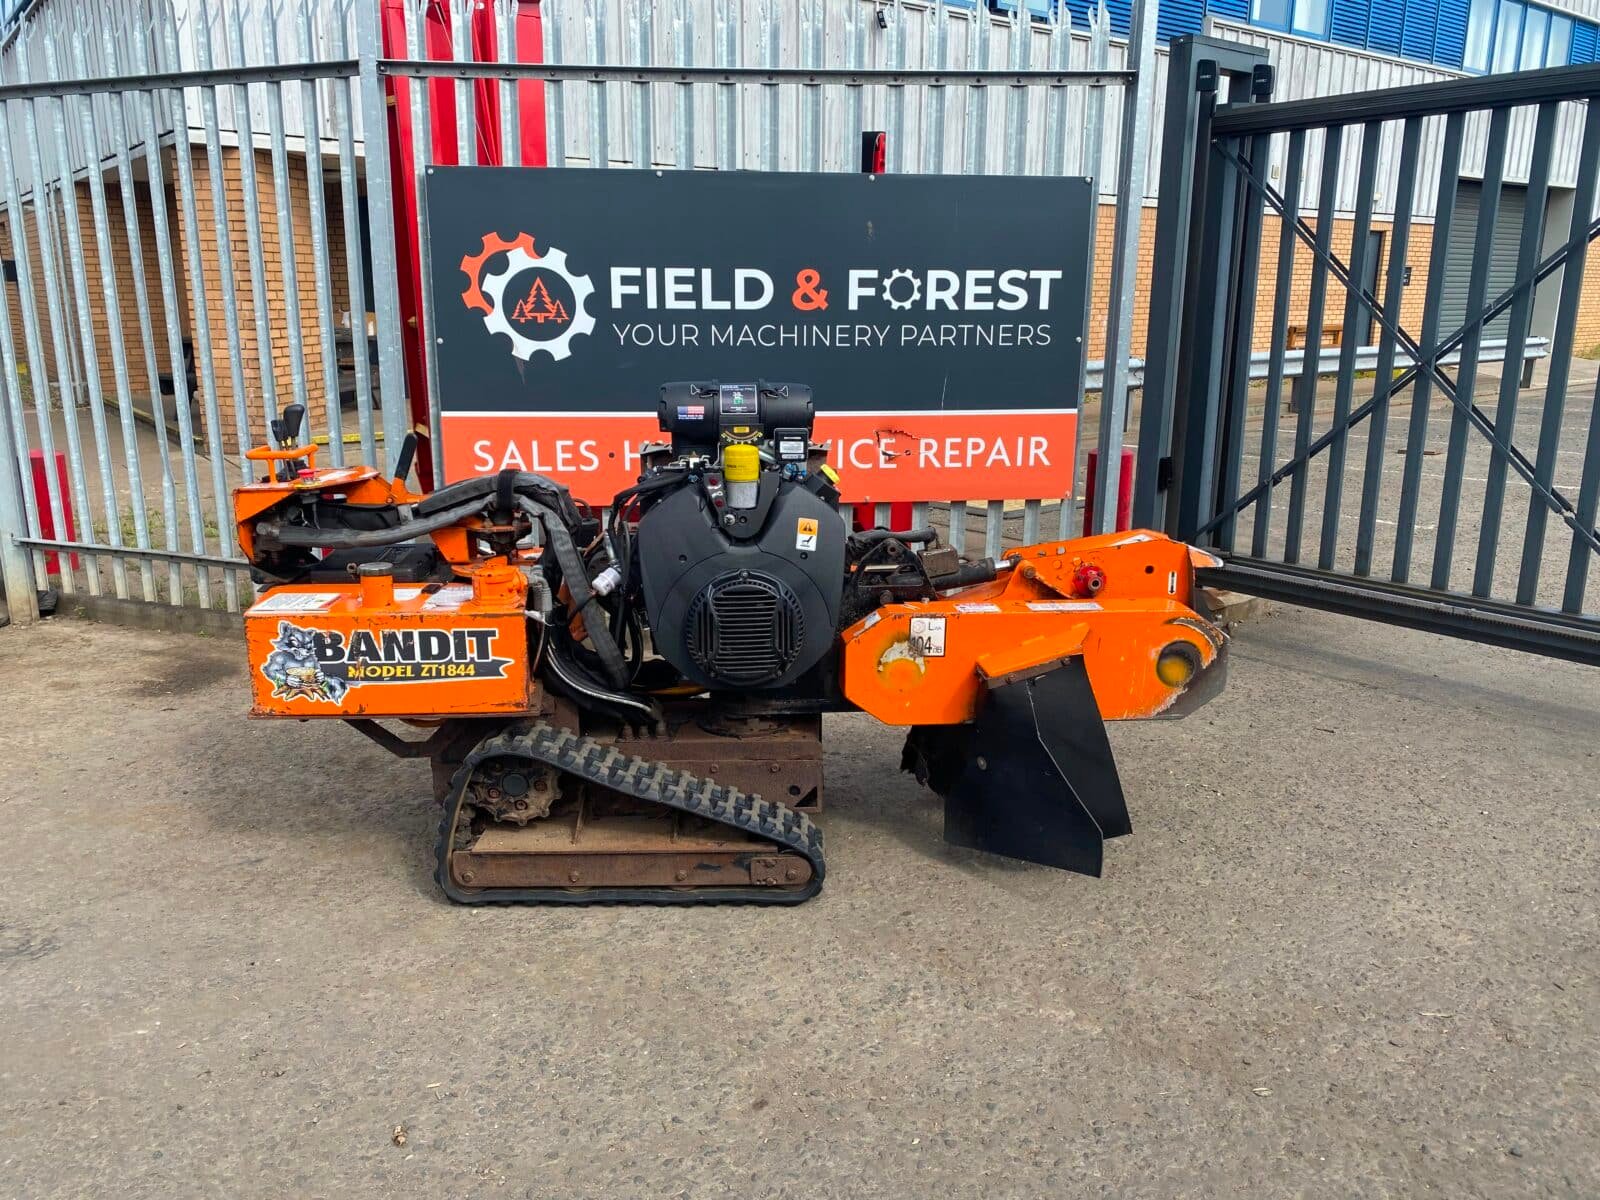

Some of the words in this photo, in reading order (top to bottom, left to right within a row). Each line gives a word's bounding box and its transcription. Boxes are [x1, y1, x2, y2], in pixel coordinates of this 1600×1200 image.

[610, 267, 774, 310] FIELD
[791, 268, 829, 311] &
[848, 268, 1062, 311] FOREST
[612, 323, 699, 347] YOUR
[711, 324, 890, 347] MACHINERY
[900, 323, 1051, 347] PARTNERS
[473, 440, 600, 472] SALES
[919, 436, 1051, 468] REPAIR
[314, 629, 497, 663] BANDIT
[347, 664, 415, 679] MODEL
[420, 663, 476, 678] ZT1844
